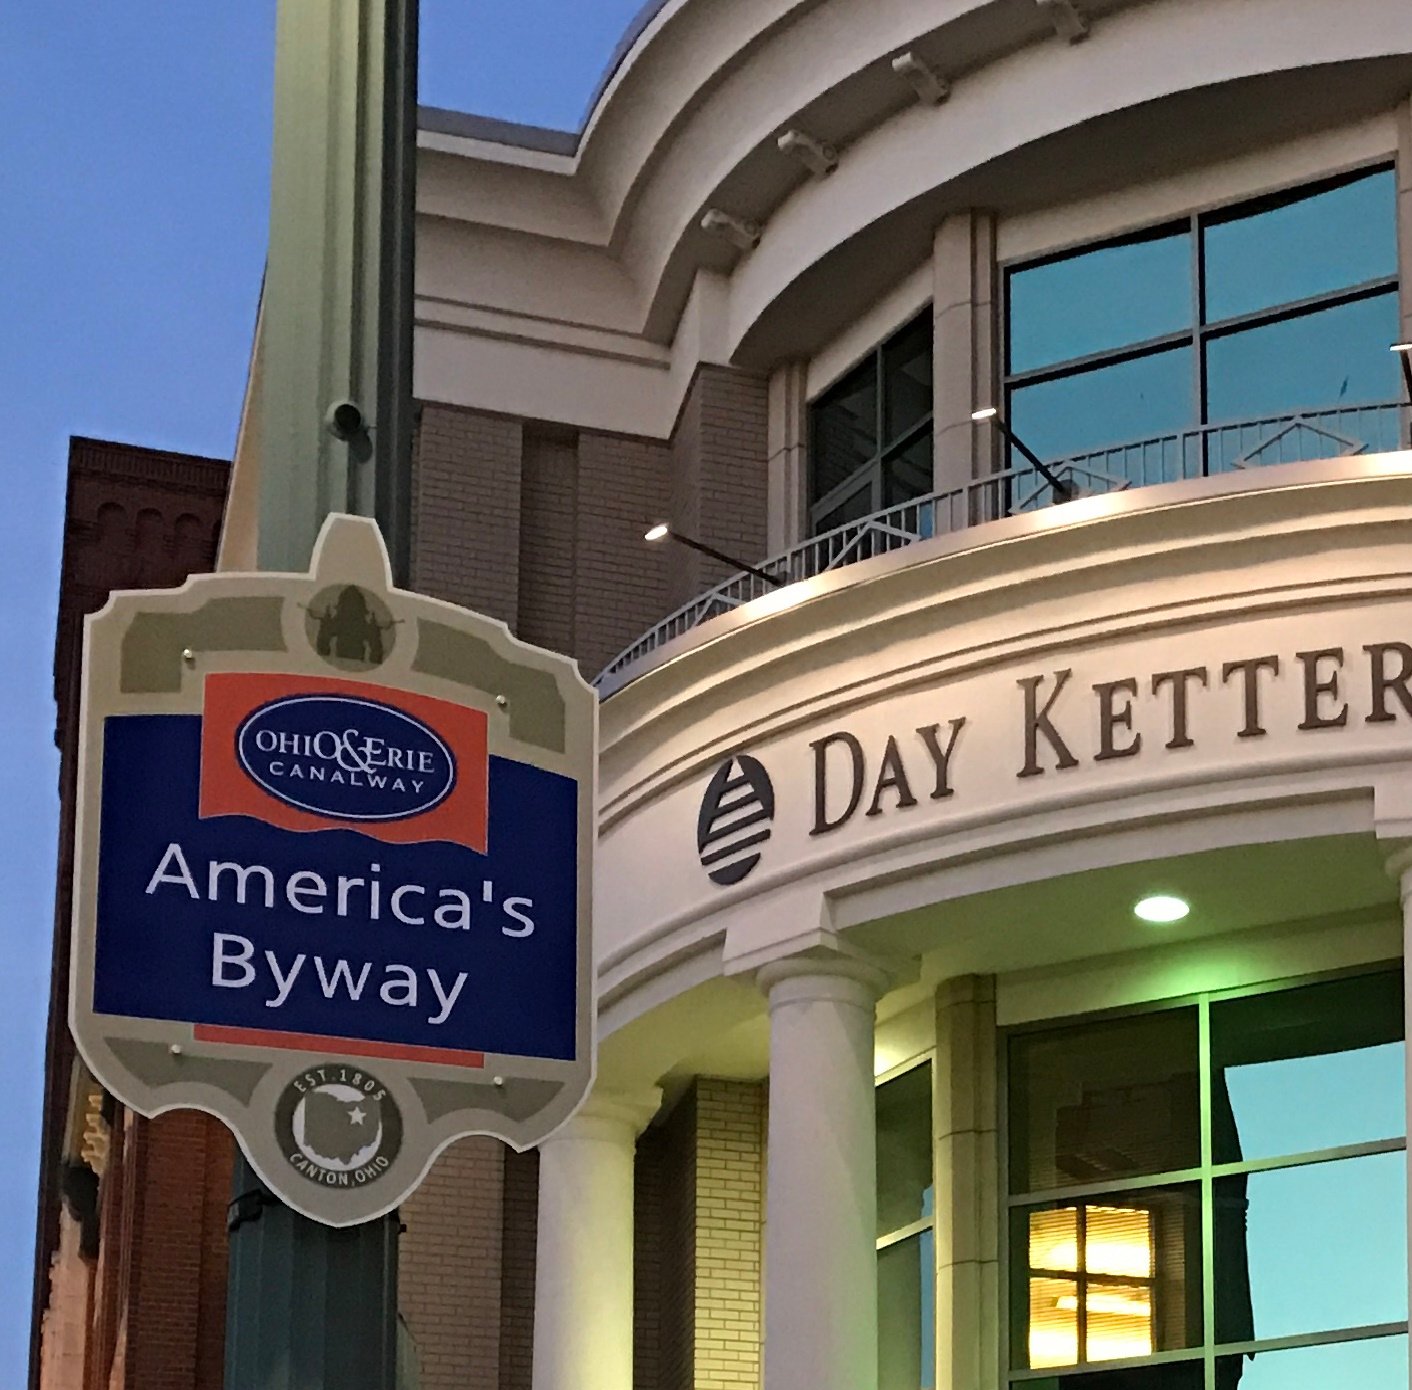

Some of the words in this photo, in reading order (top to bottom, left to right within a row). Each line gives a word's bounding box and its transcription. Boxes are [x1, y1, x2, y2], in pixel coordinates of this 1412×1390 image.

[269, 761, 424, 793] CANALWAY
[809, 717, 967, 836] DAY
[146, 843, 536, 938] America's
[211, 932, 469, 1025] Byway
